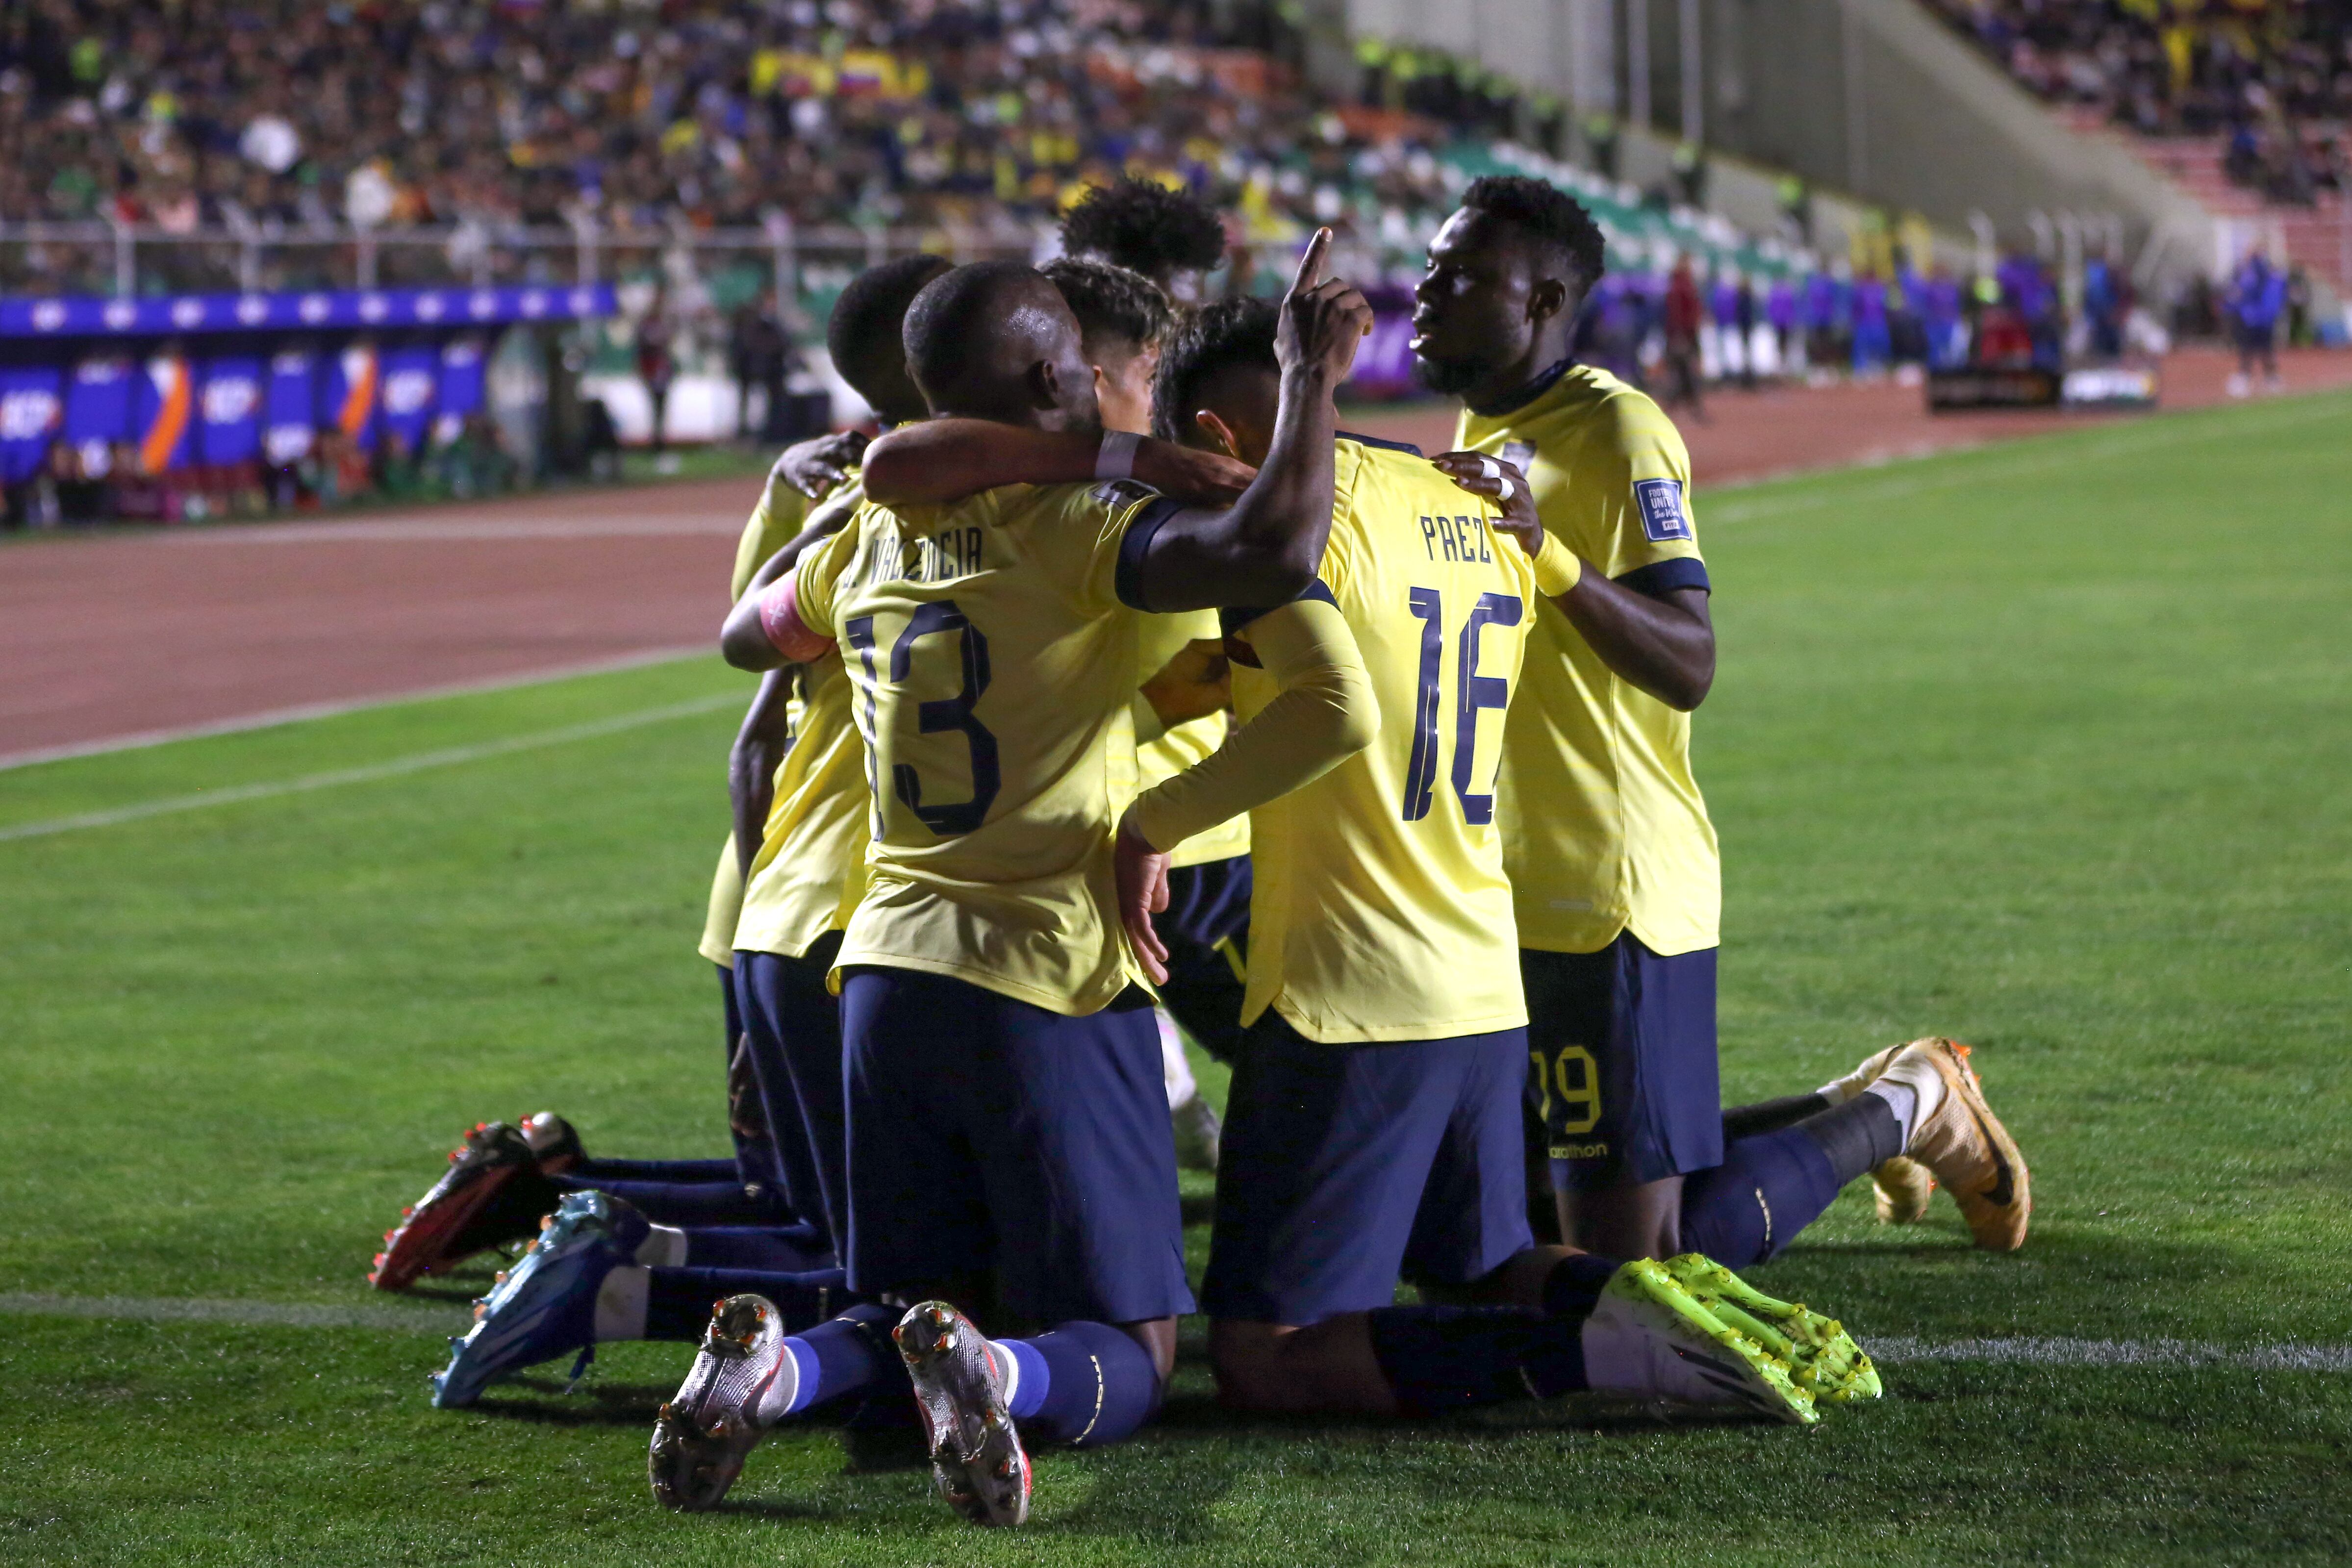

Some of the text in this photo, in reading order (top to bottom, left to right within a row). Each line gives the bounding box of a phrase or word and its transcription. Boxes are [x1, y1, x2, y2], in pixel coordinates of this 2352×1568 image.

[1420, 516, 1491, 564] PAEZ
[845, 600, 1002, 842] 13
[1403, 586, 1522, 825] 16
[1530, 1045, 1603, 1135] 19
[1549, 1143, 1608, 1159] arathon
